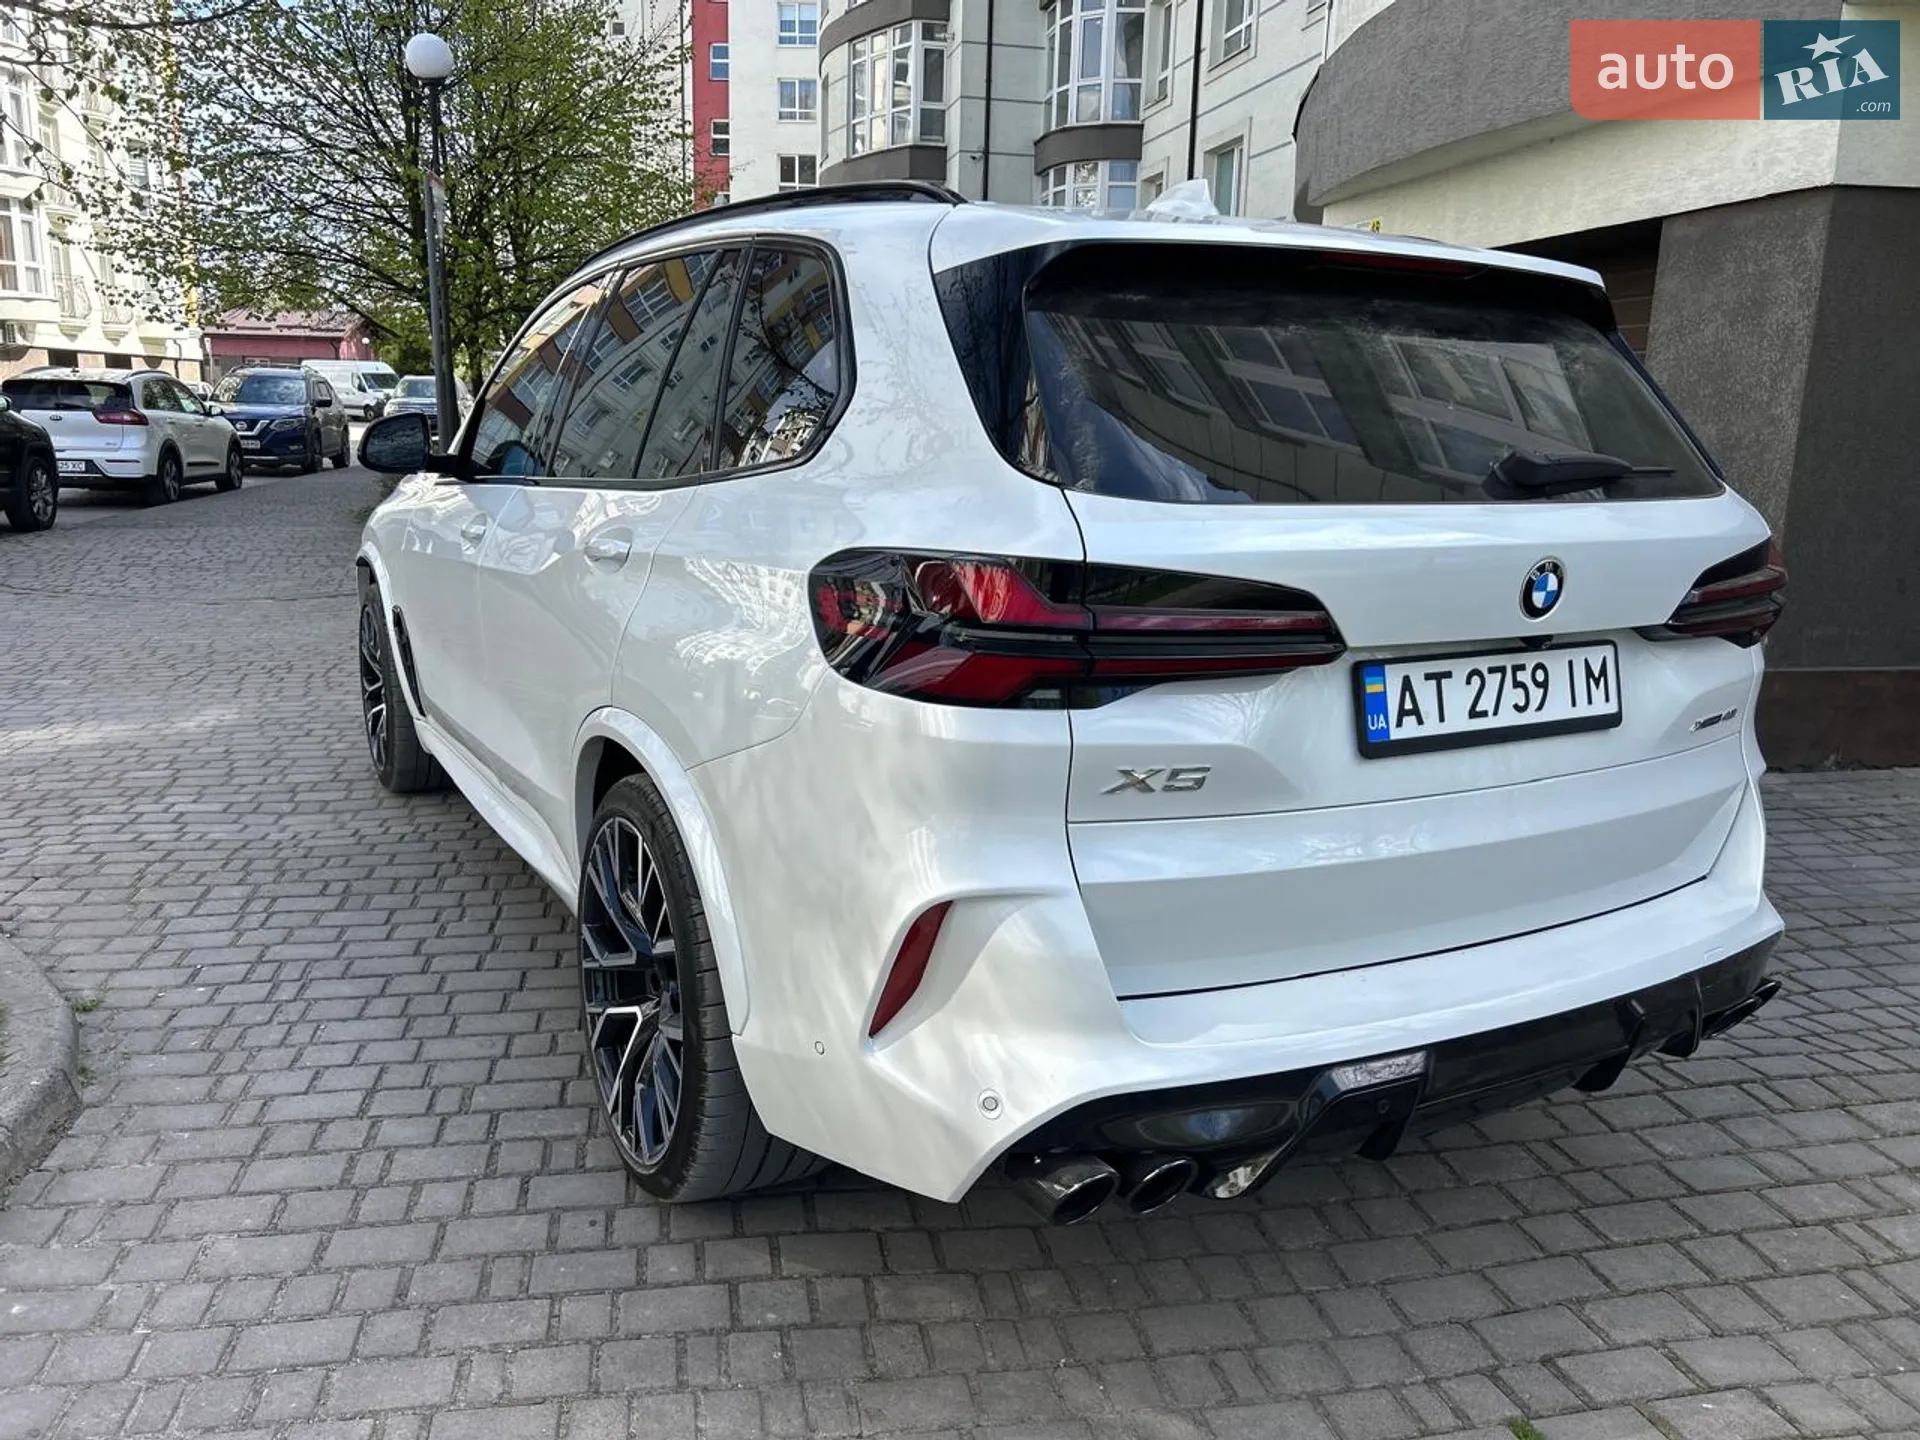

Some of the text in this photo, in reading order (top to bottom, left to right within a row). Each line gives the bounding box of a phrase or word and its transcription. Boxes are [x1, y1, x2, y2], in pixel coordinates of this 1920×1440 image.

[1395, 655, 1610, 729] AT 2759 IM
[1367, 717, 1388, 731] UA
[1101, 765, 1213, 796] X5
